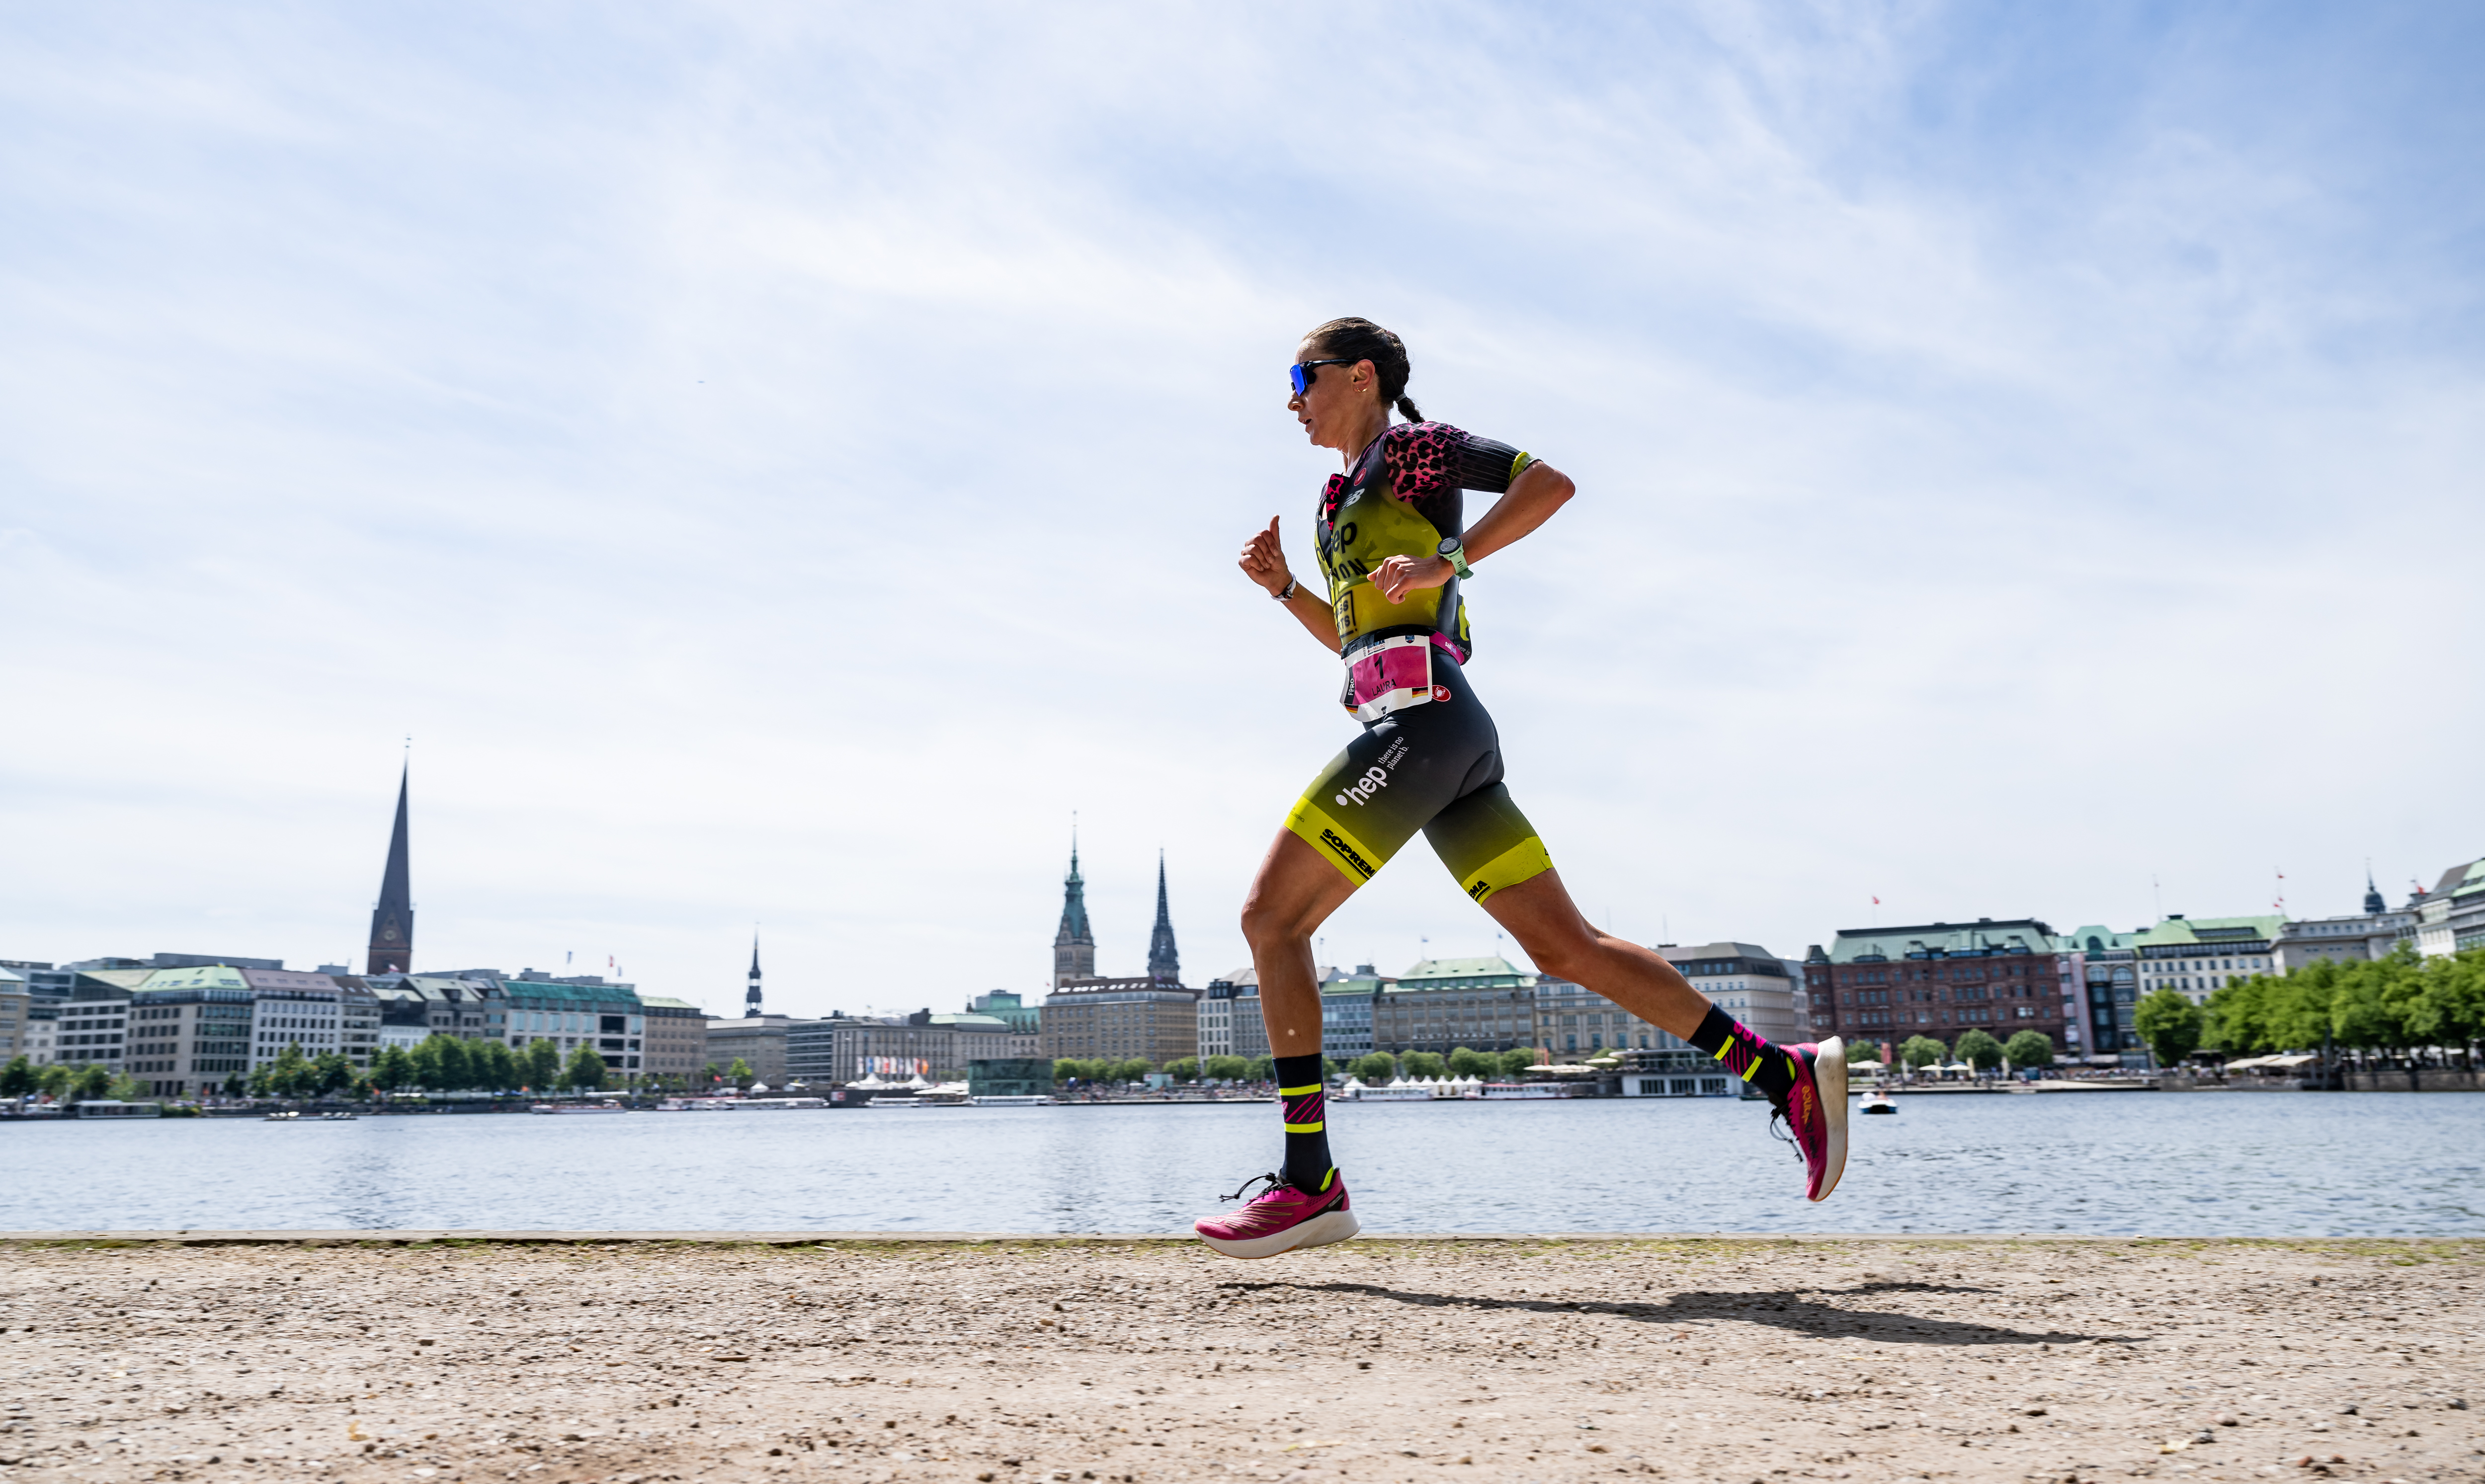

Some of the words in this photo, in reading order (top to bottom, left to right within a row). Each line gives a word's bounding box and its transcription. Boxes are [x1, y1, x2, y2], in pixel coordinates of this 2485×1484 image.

[1374, 655, 1384, 679] 1
[1372, 678, 1397, 696] LAURA
[1378, 749, 1394, 764] there
[1395, 737, 1404, 745] no
[1387, 750, 1405, 770] planet
[1342, 766, 1388, 806] hep
[1322, 828, 1377, 878] SOPREM
